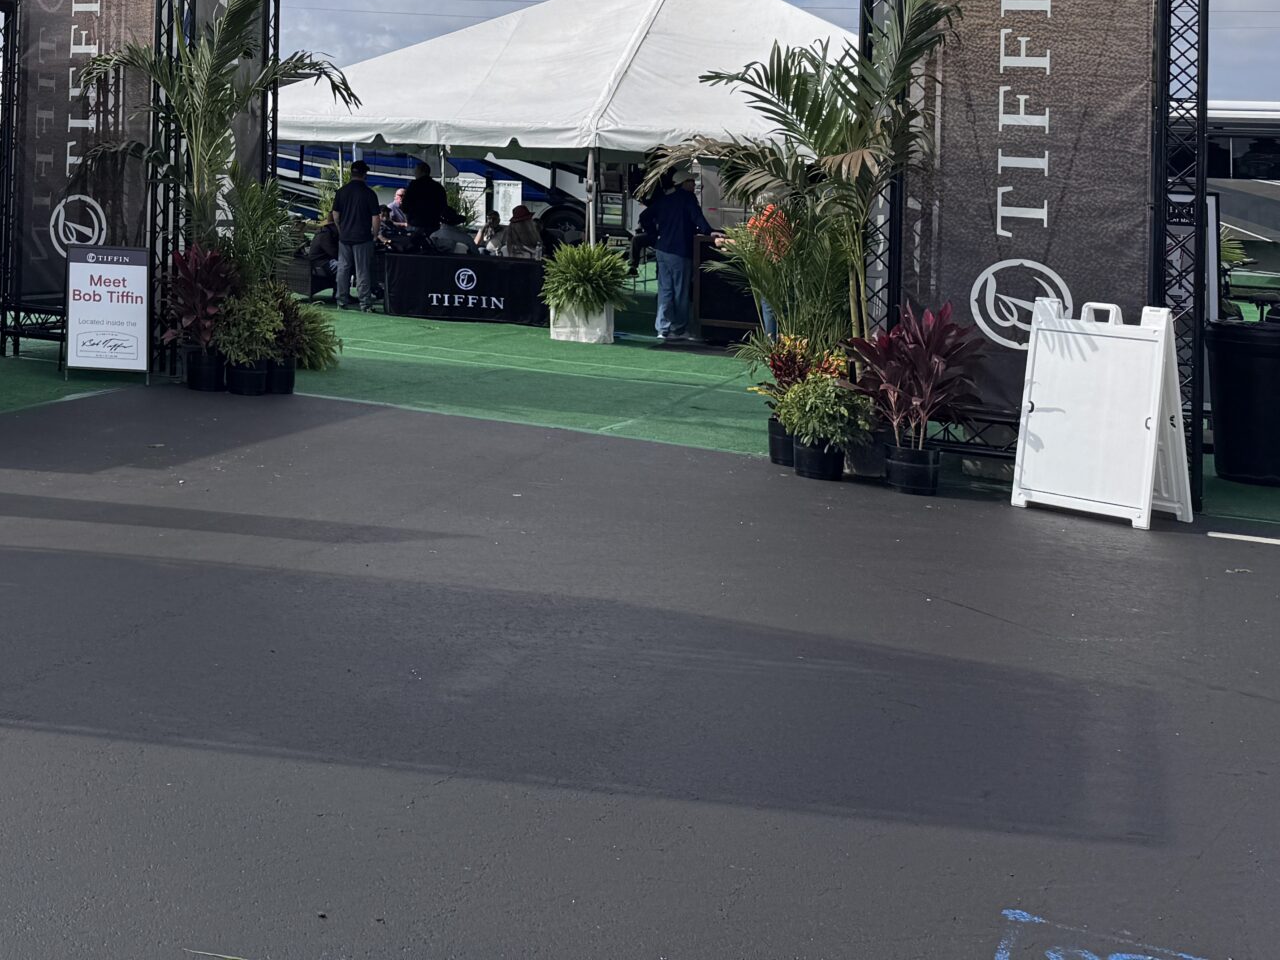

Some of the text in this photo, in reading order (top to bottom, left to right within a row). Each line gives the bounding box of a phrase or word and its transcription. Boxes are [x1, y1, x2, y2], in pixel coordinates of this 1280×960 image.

[97, 254, 130, 263] TIFFIN
[89, 274, 127, 288] Meet
[72, 289, 144, 305] Bob Tiffin
[428, 293, 505, 310] TIFFIN
